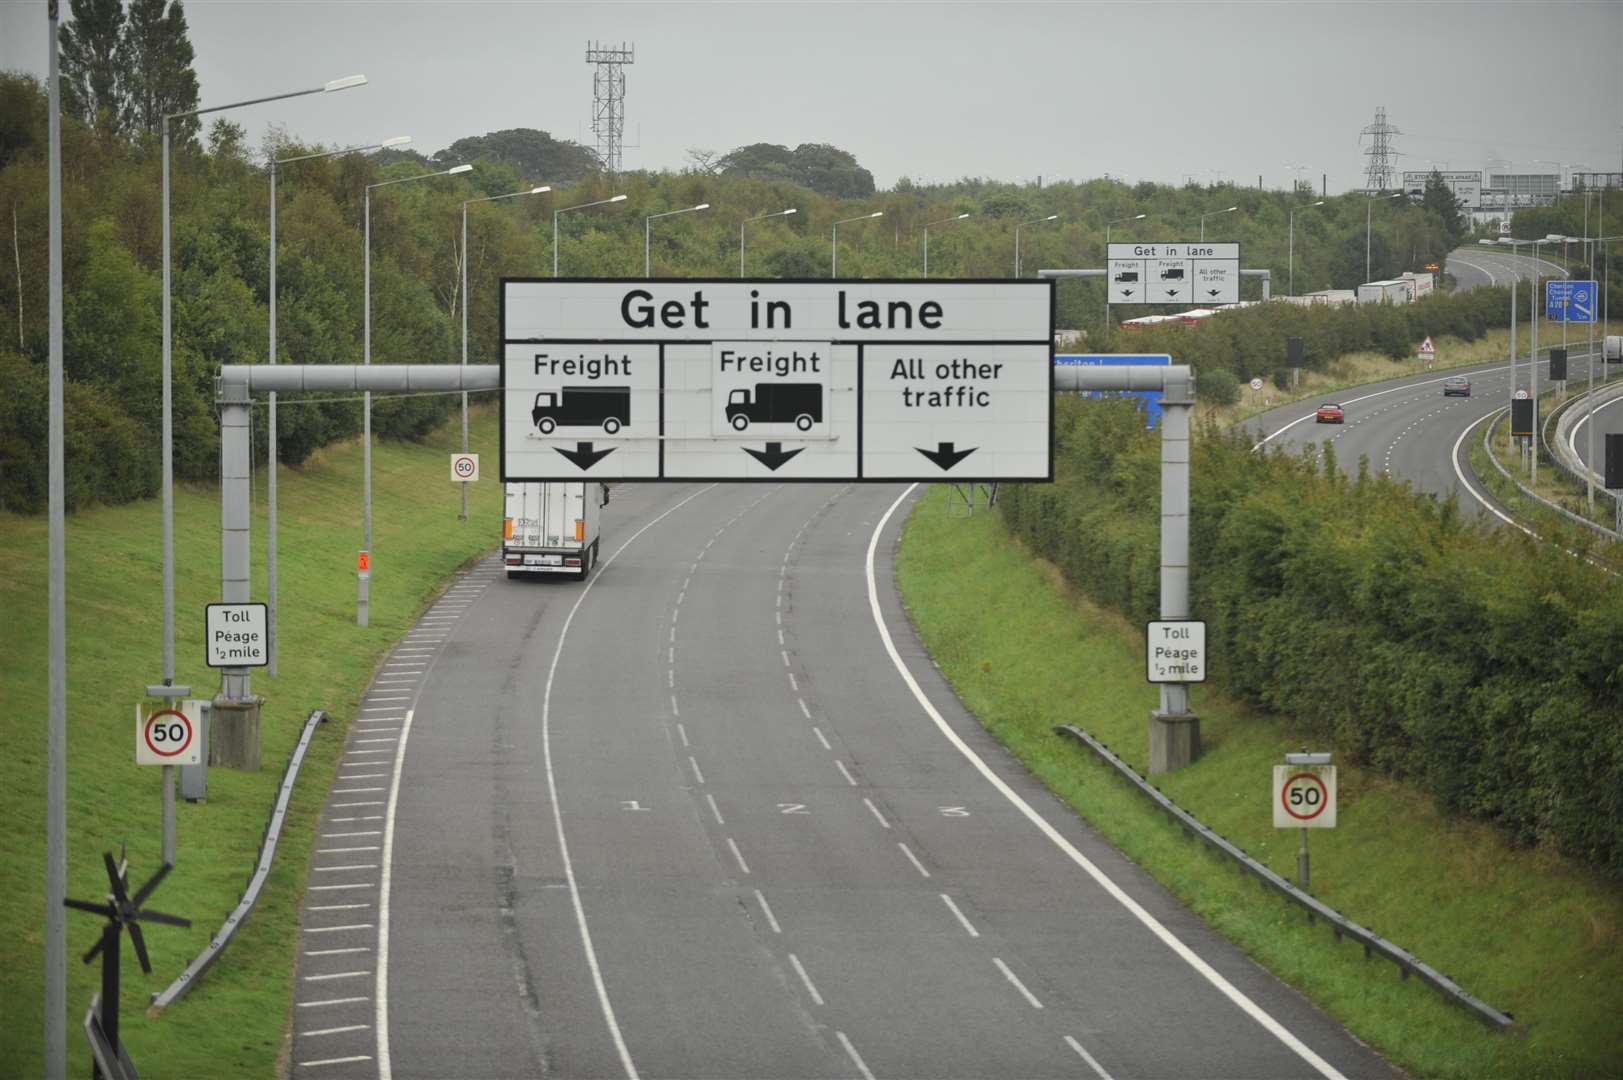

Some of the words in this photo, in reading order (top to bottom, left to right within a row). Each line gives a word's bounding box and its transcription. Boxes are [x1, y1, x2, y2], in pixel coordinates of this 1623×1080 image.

[1134, 246, 1156, 256] Get
[1166, 246, 1177, 256] in
[1186, 246, 1213, 256] lane
[1114, 261, 1139, 269] Freight
[1158, 260, 1184, 269] Freight
[620, 289, 710, 329] Get
[750, 289, 792, 329] in
[838, 290, 944, 329] lane
[534, 353, 632, 380] Freight
[720, 350, 821, 377] Freight
[890, 358, 925, 380] All
[935, 358, 1003, 380] other
[902, 385, 991, 408] traffic
[458, 463, 472, 472] 50
[222, 611, 251, 623] Toll
[215, 630, 259, 644] Péage
[1162, 627, 1190, 640] Toll
[229, 646, 260, 658] mile
[1168, 663, 1199, 675] mile
[154, 724, 184, 742] 50
[1290, 787, 1320, 806] 50
